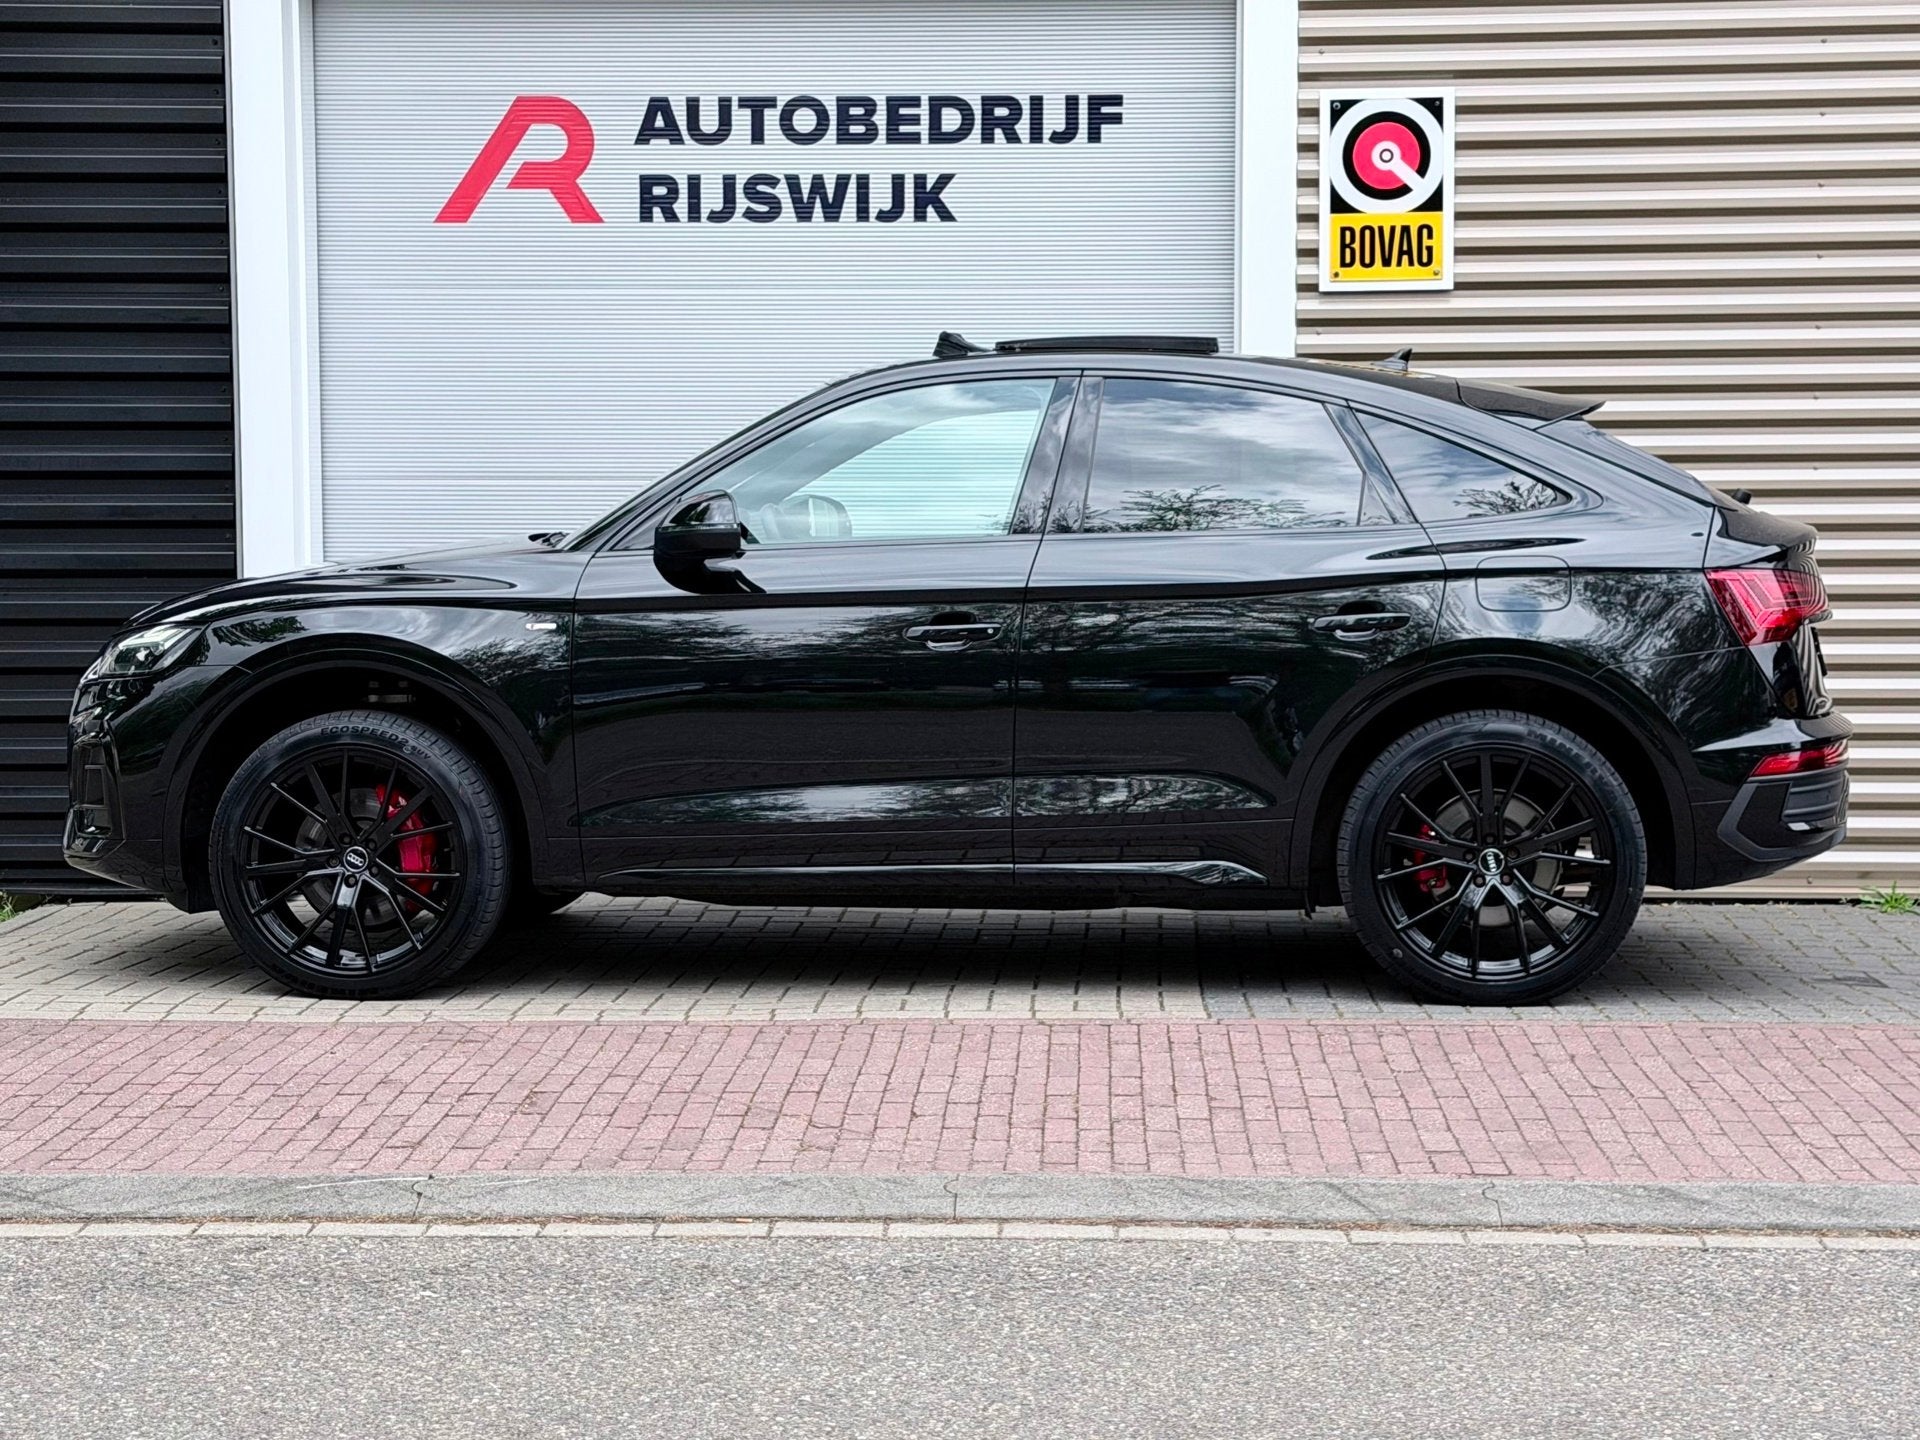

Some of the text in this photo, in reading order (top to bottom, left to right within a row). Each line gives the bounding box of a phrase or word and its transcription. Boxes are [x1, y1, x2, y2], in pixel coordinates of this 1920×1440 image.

[634, 94, 1124, 146] AUTOBEDRIJF
[639, 173, 958, 223] RIJSWIJK
[1339, 224, 1434, 268] BOVAG
